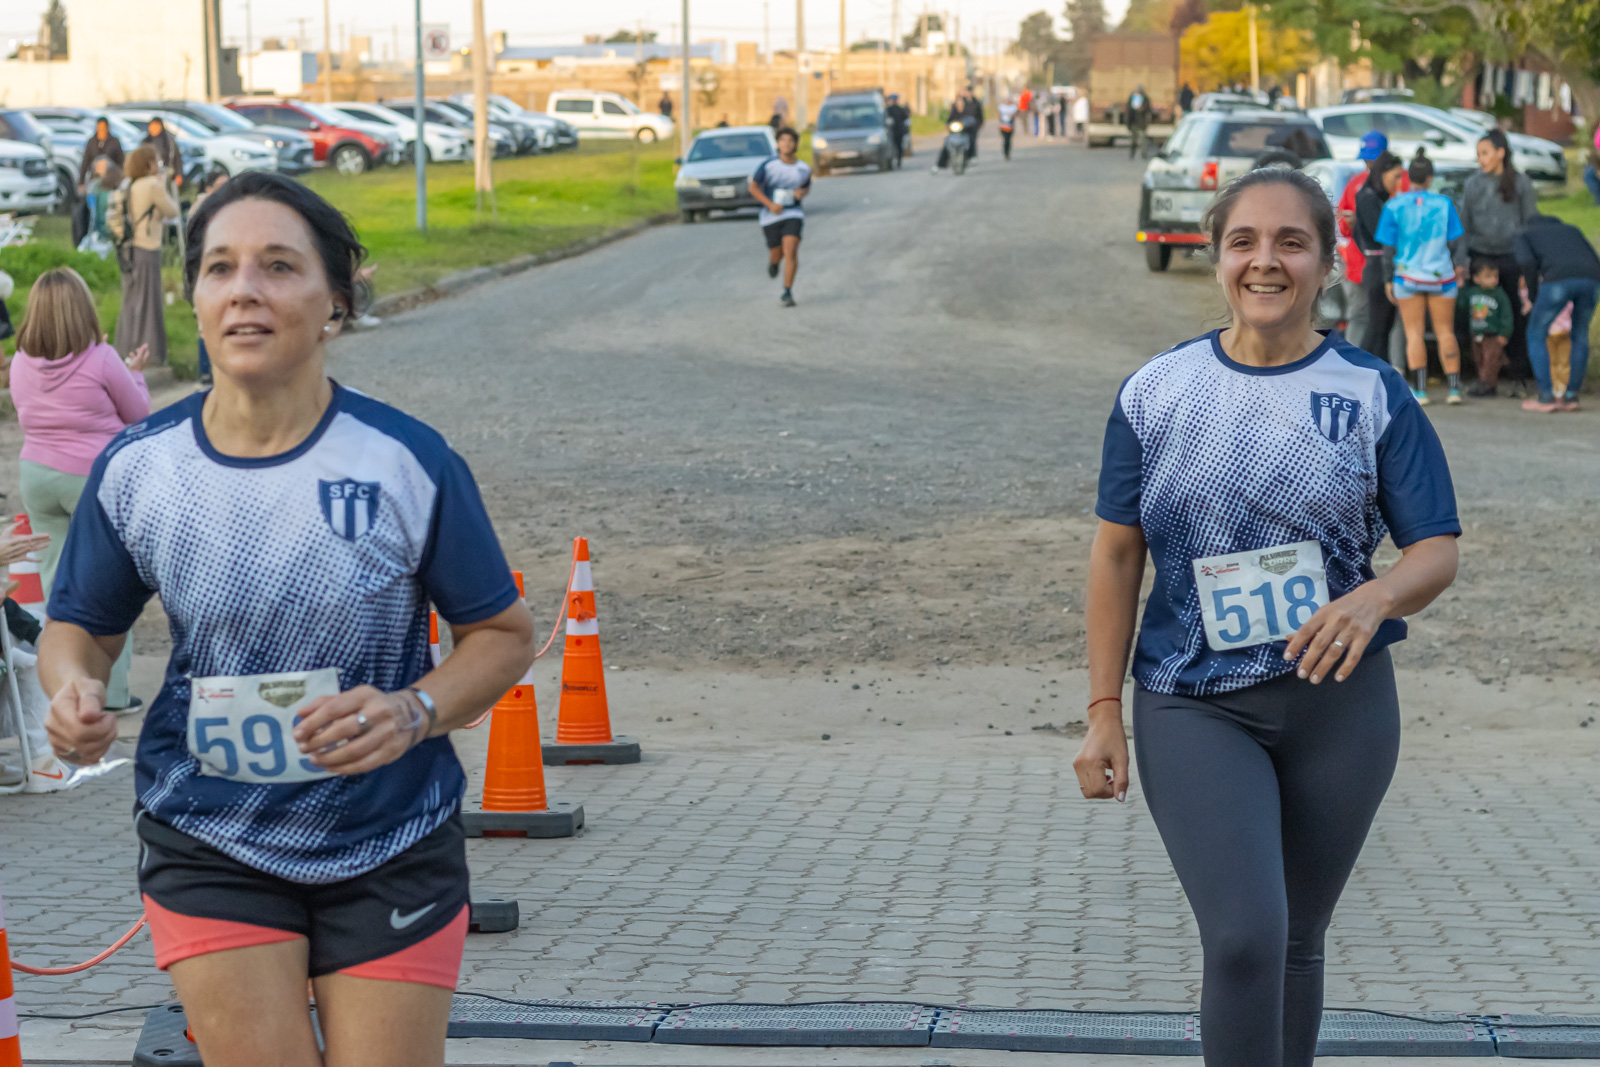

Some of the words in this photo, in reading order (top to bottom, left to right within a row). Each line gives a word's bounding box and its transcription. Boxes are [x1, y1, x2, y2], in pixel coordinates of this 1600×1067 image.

[1320, 396, 1352, 411] SFC
[329, 483, 370, 499] SFC
[1260, 549, 1298, 561] ALVAREZ
[1261, 556, 1298, 569] CORRE
[1211, 575, 1320, 644] 518
